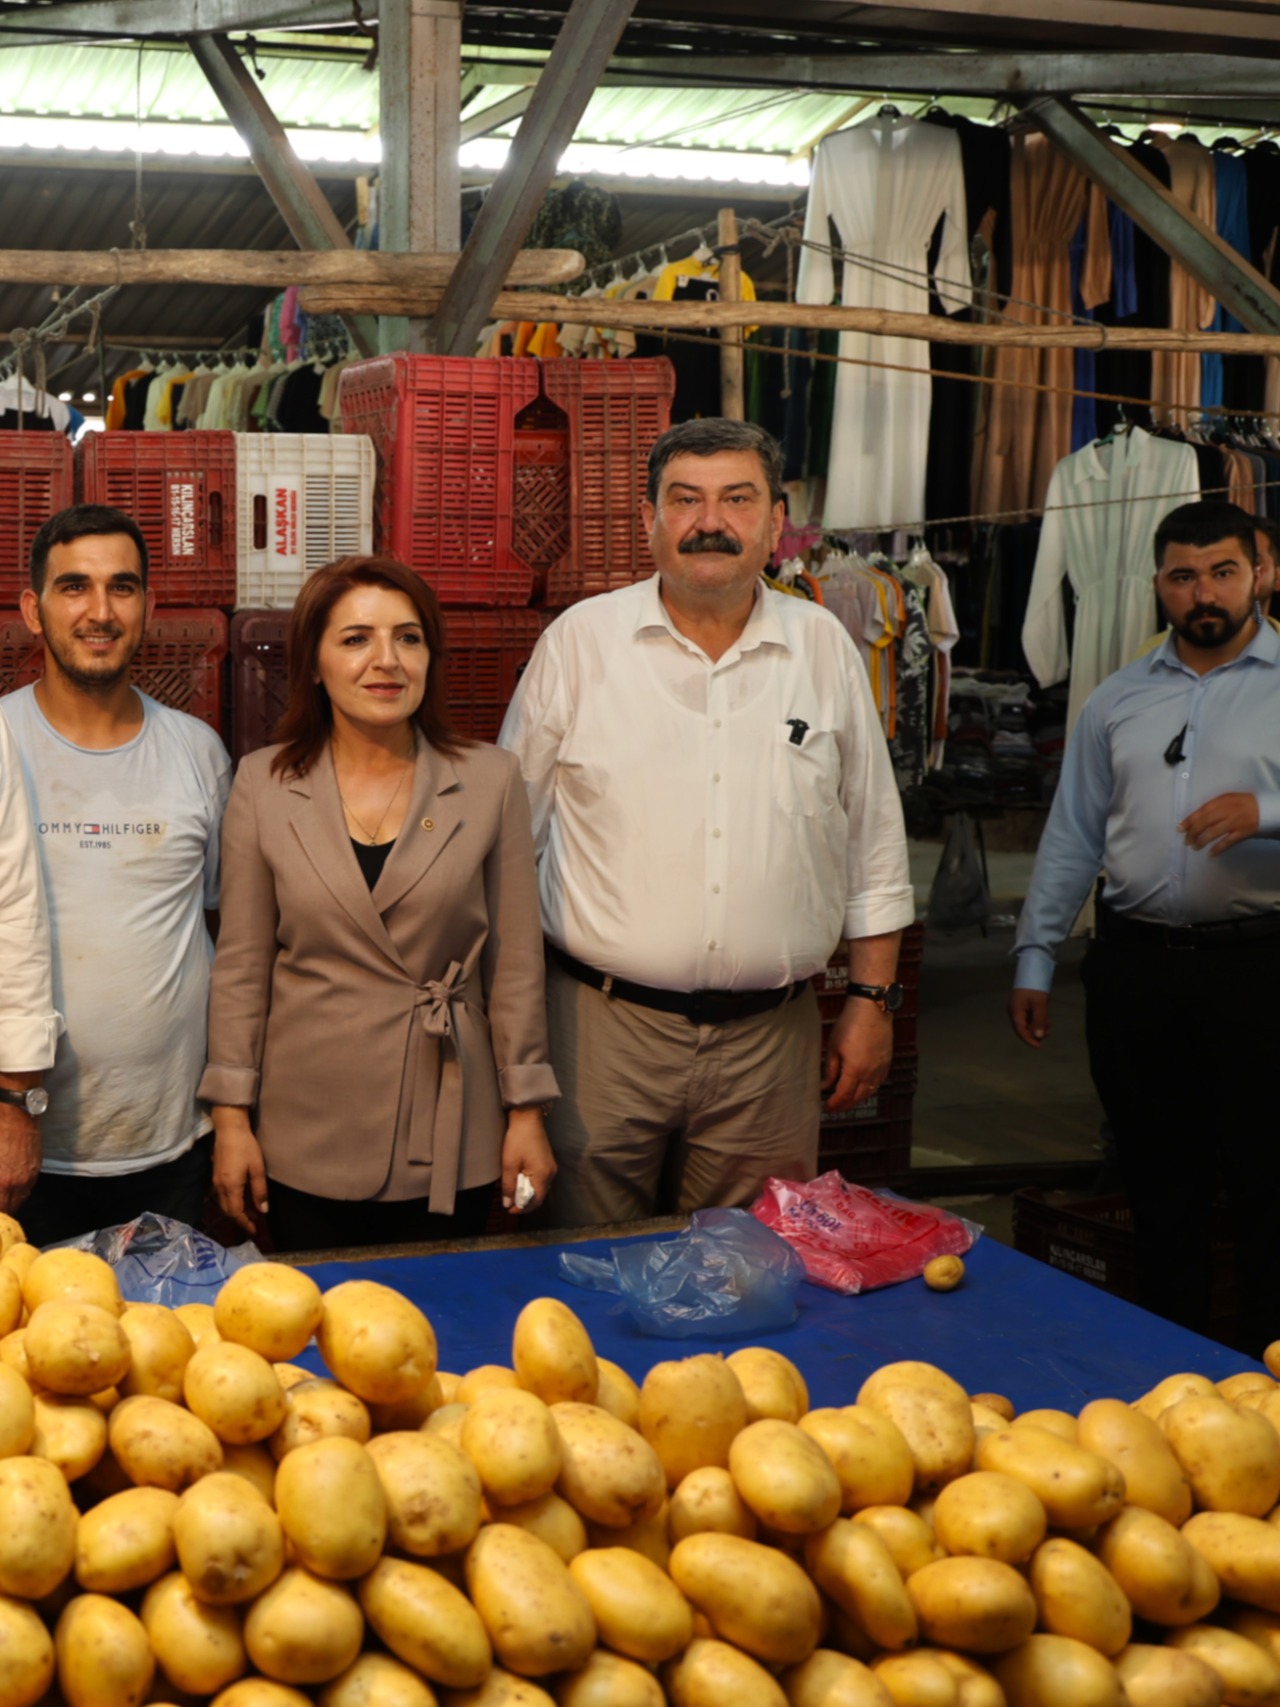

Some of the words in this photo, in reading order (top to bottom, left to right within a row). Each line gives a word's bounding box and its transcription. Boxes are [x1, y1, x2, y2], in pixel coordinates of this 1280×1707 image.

[179, 484, 195, 556] KILINÇARSLAN
[275, 488, 290, 556] ALAŞKAN
[34, 822, 81, 834] OMMY
[102, 823, 161, 835] HILFIGER
